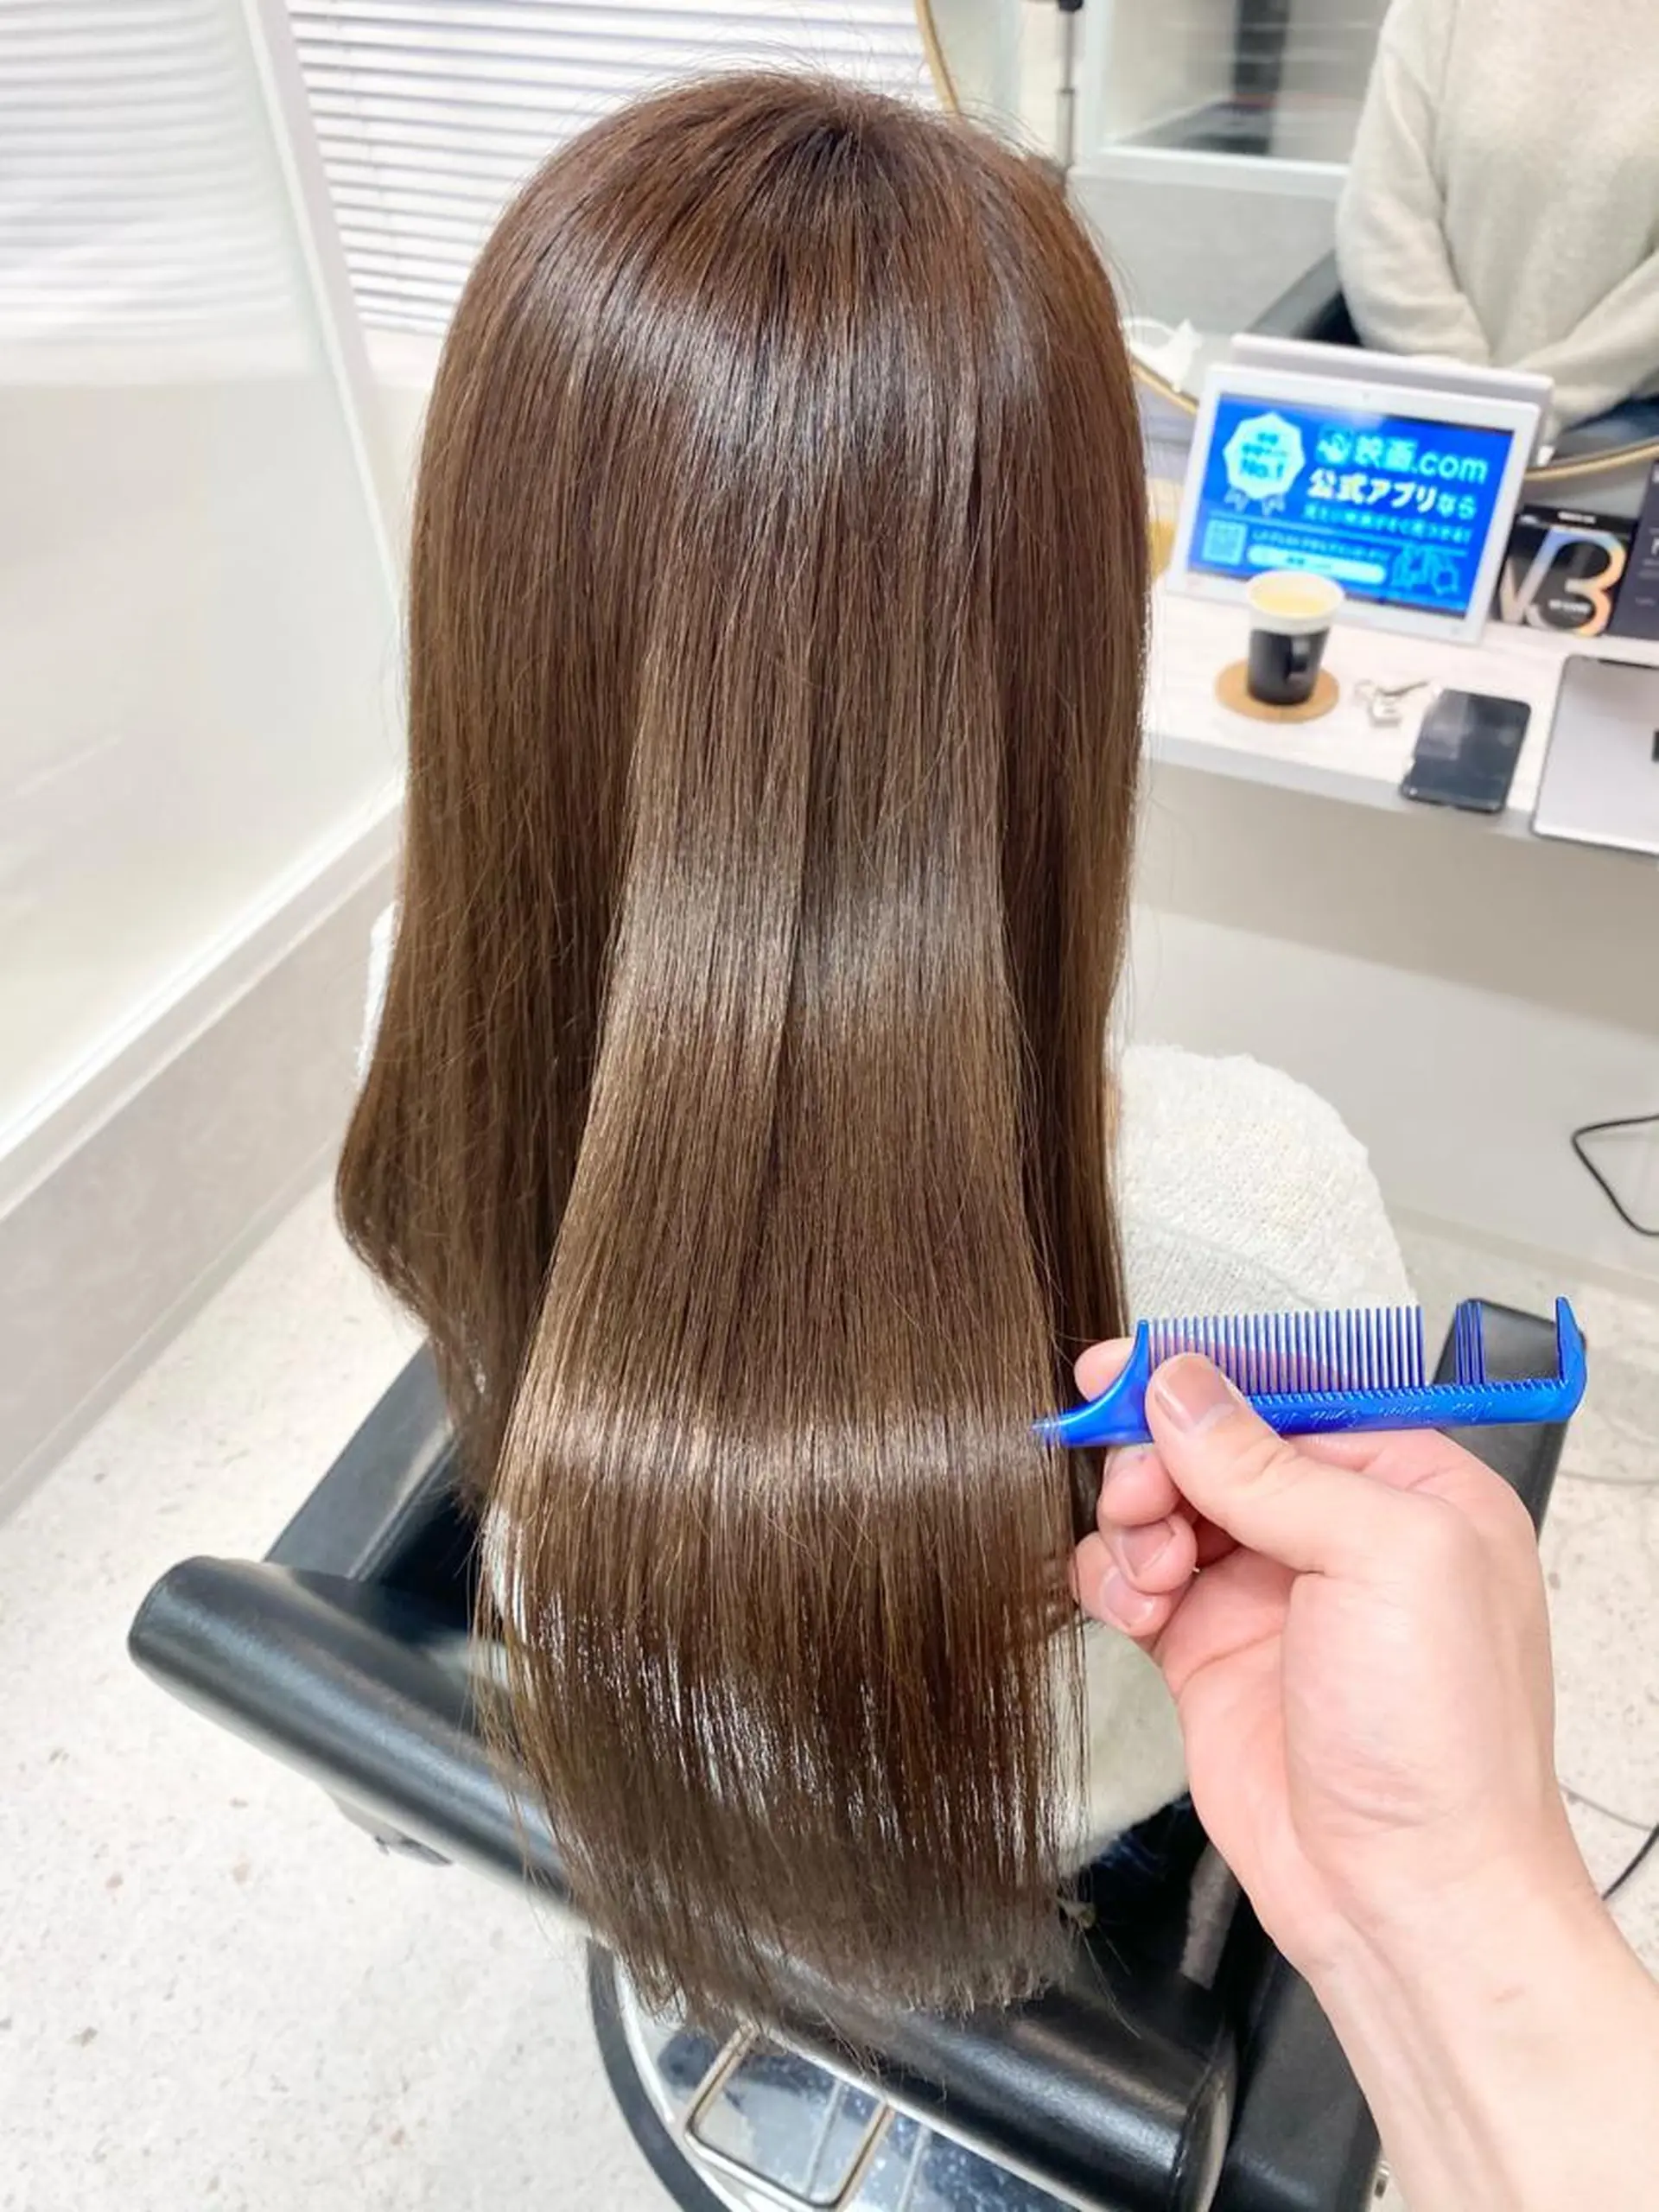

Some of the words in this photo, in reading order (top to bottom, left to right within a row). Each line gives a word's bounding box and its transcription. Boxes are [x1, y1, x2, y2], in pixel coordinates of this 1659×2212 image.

[1354, 435, 1488, 484] 映画.com
[1306, 467, 1477, 520] 公式アプリなら
[1499, 524, 1626, 638] V3
